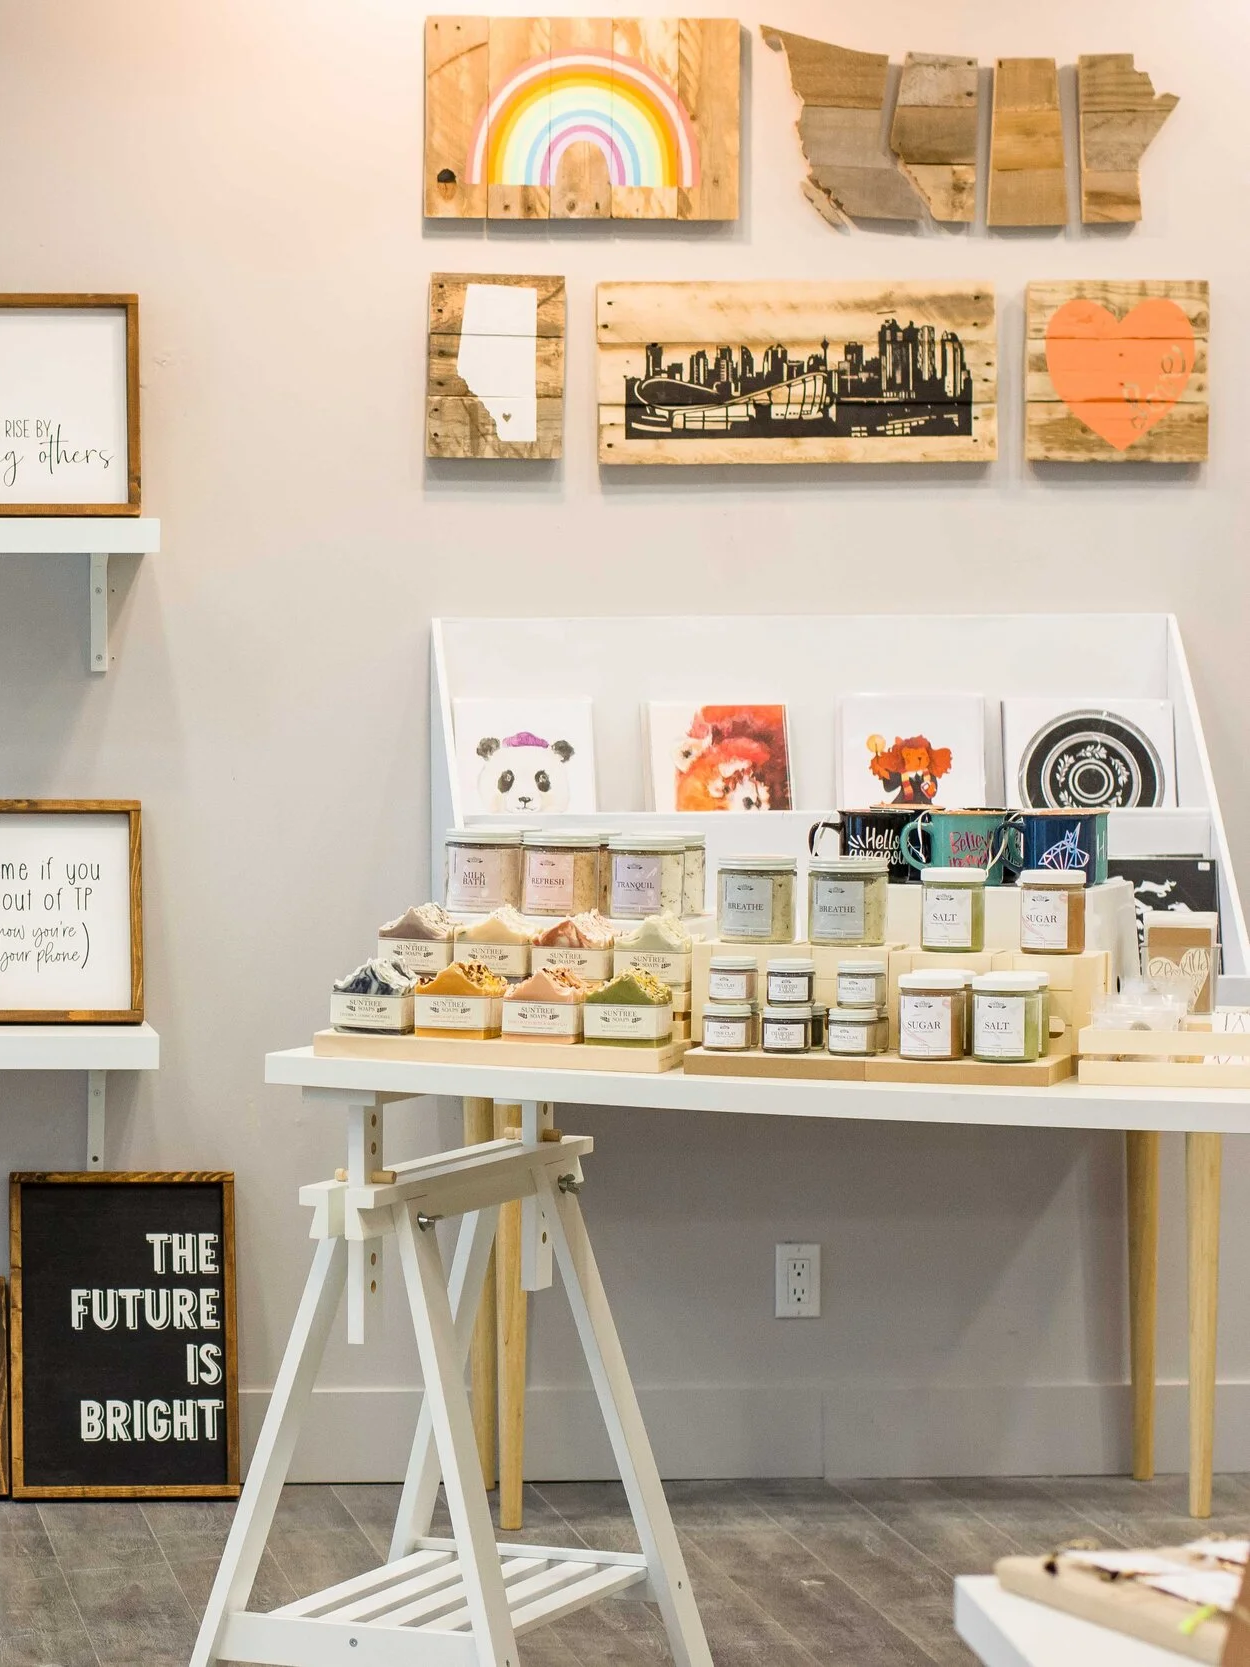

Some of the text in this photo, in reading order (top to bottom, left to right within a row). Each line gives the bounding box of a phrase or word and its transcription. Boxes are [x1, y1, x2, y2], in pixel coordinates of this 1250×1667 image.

[5, 420, 29, 438] RISE
[35, 418, 51, 438] BY
[38, 423, 116, 474] others
[865, 826, 900, 850] Hello
[949, 830, 995, 854] Believ
[2, 863, 28, 880] me
[41, 857, 53, 880] if
[66, 863, 100, 885] you
[462, 871, 486, 879] MILK
[462, 878, 486, 886] BATH
[531, 877, 565, 886] REFRESH
[617, 881, 655, 891] TRANQUIL
[3, 889, 31, 911] out
[44, 888, 63, 910] of
[75, 887, 92, 910] TP
[727, 903, 764, 911] BREATHE
[819, 905, 856, 913] BREATHE
[932, 913, 958, 922] SALT
[1025, 914, 1057, 923] SUGAR
[32, 921, 77, 948] you're
[907, 1021, 942, 1030] SUGAR
[984, 1021, 1010, 1031] SALT
[145, 1233, 220, 1274] THE
[70, 1288, 220, 1331] FUTURE
[186, 1343, 223, 1386] IS
[80, 1399, 224, 1442] BRIGHT
